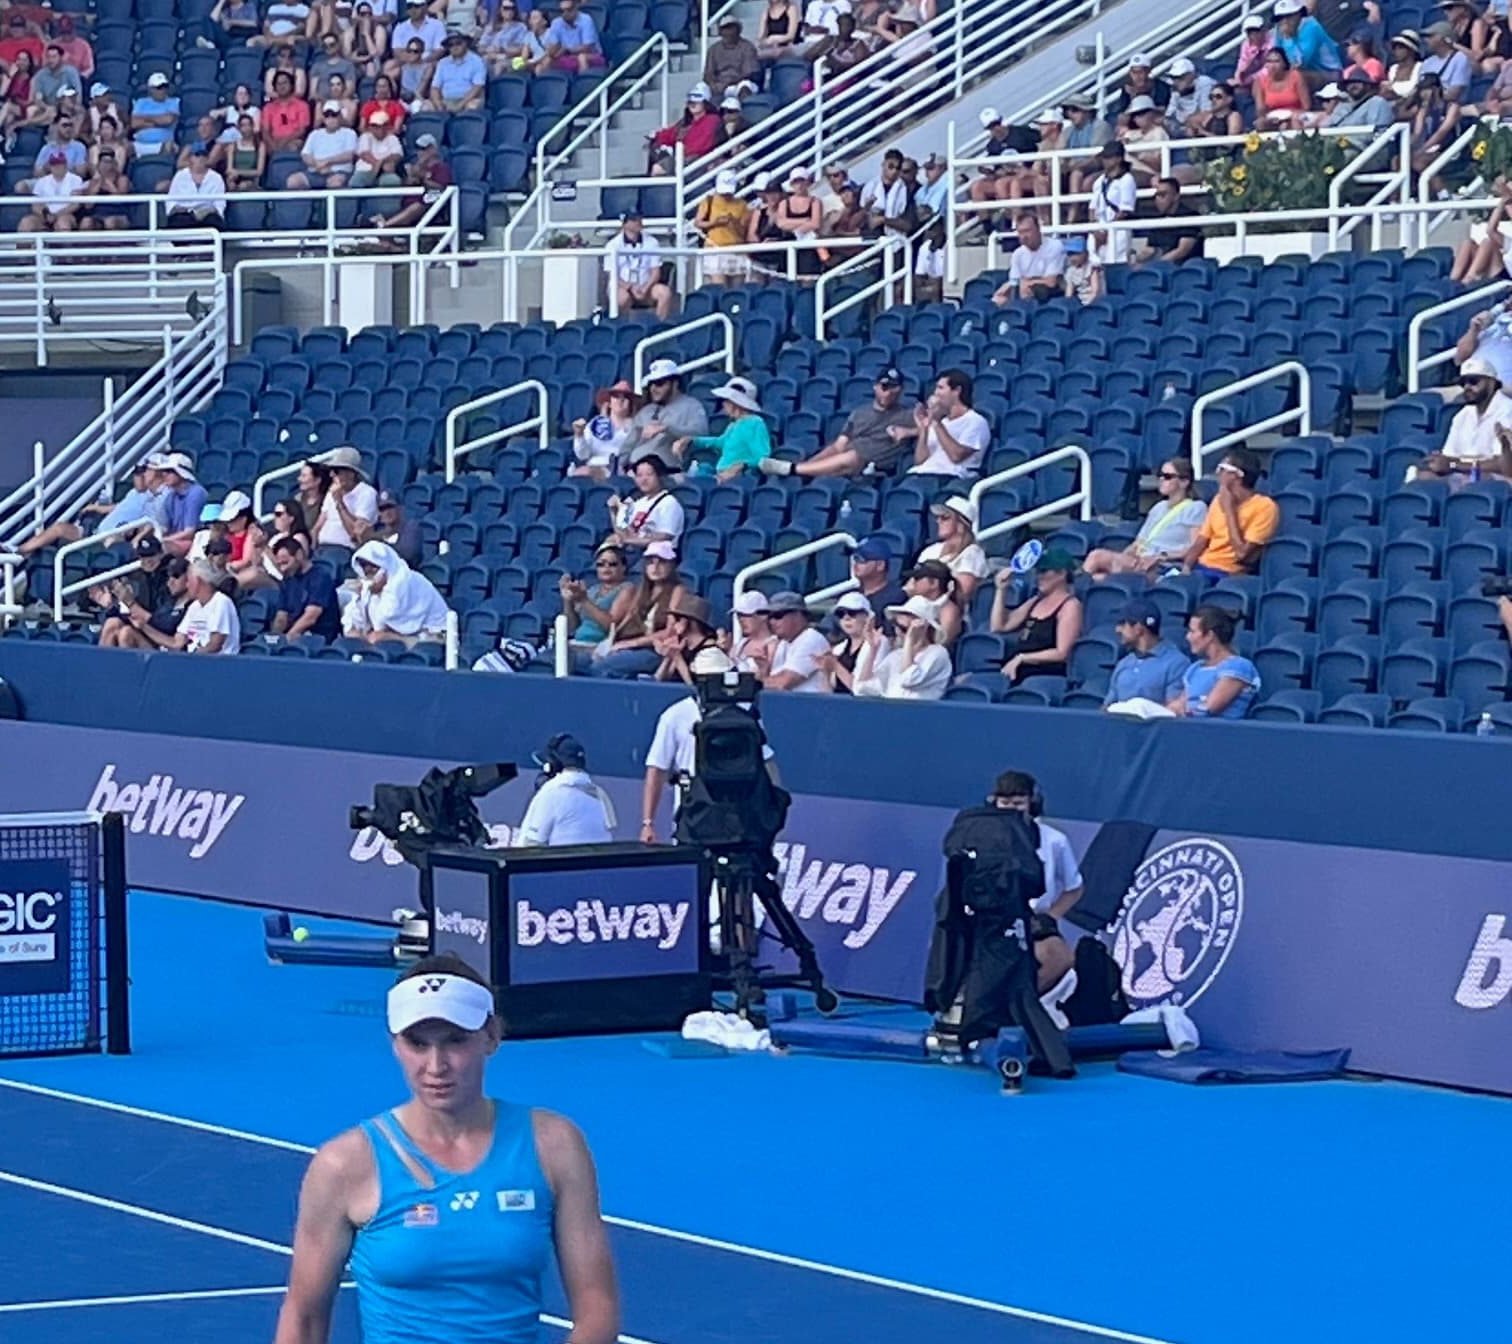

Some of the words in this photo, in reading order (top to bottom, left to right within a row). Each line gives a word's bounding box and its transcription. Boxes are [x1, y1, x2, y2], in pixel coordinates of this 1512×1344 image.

[86, 764, 245, 859] betway
[435, 906, 488, 945] betway
[517, 898, 690, 950] betway
[1217, 872, 1237, 948] OPEN
